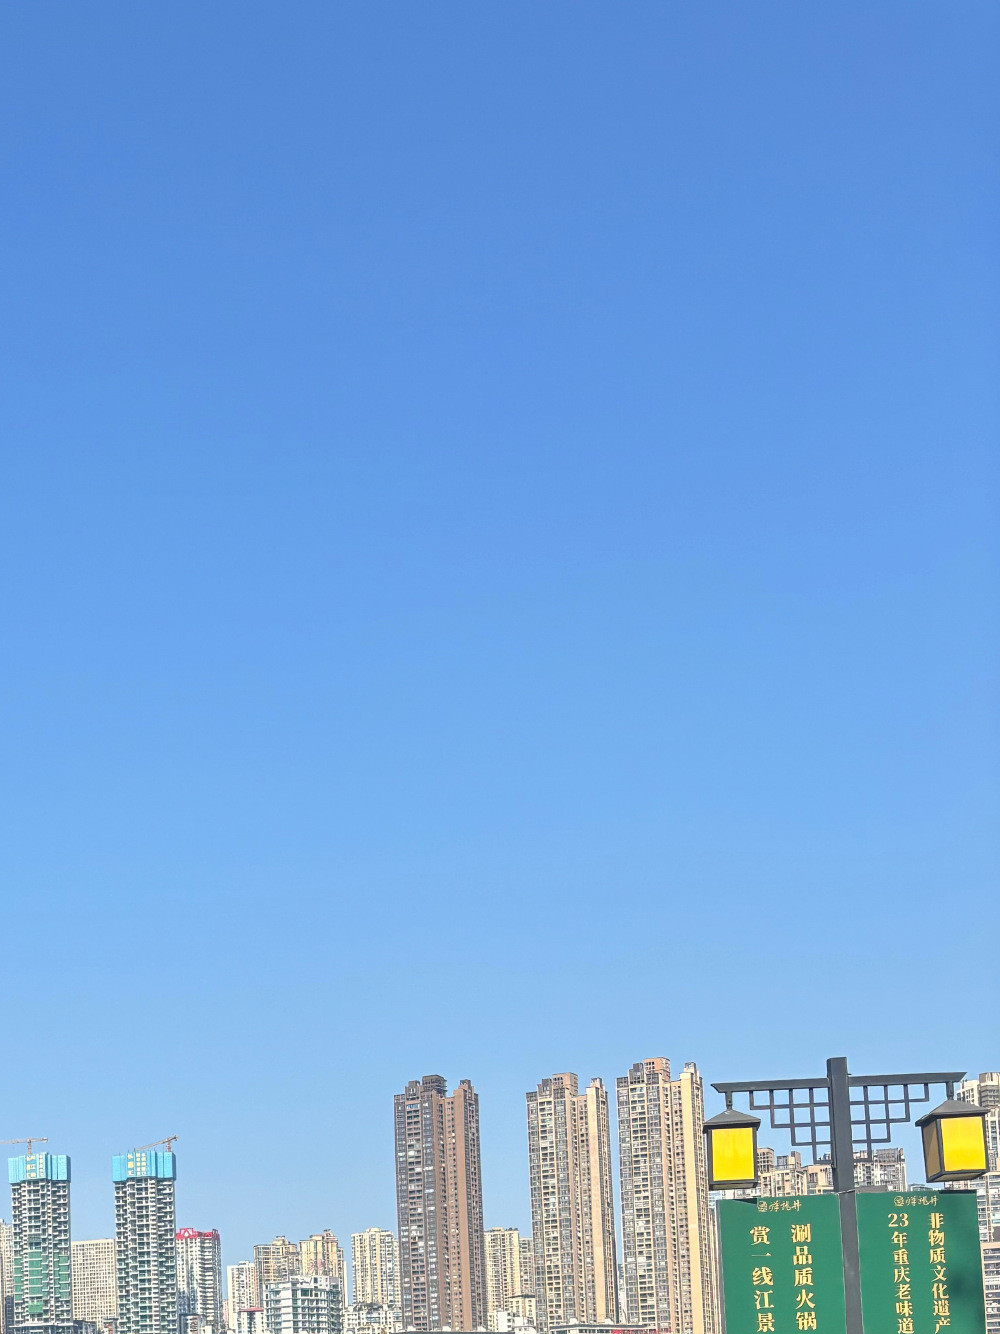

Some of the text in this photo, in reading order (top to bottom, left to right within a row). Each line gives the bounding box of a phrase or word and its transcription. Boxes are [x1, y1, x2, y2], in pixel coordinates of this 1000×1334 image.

[750, 1225, 775, 1333] 赏一线江景
[791, 1223, 817, 1331] 涮品质火锅
[888, 1213, 915, 1334] 23年重庆老味道
[928, 1212, 951, 1334] 非物质文化遗产
